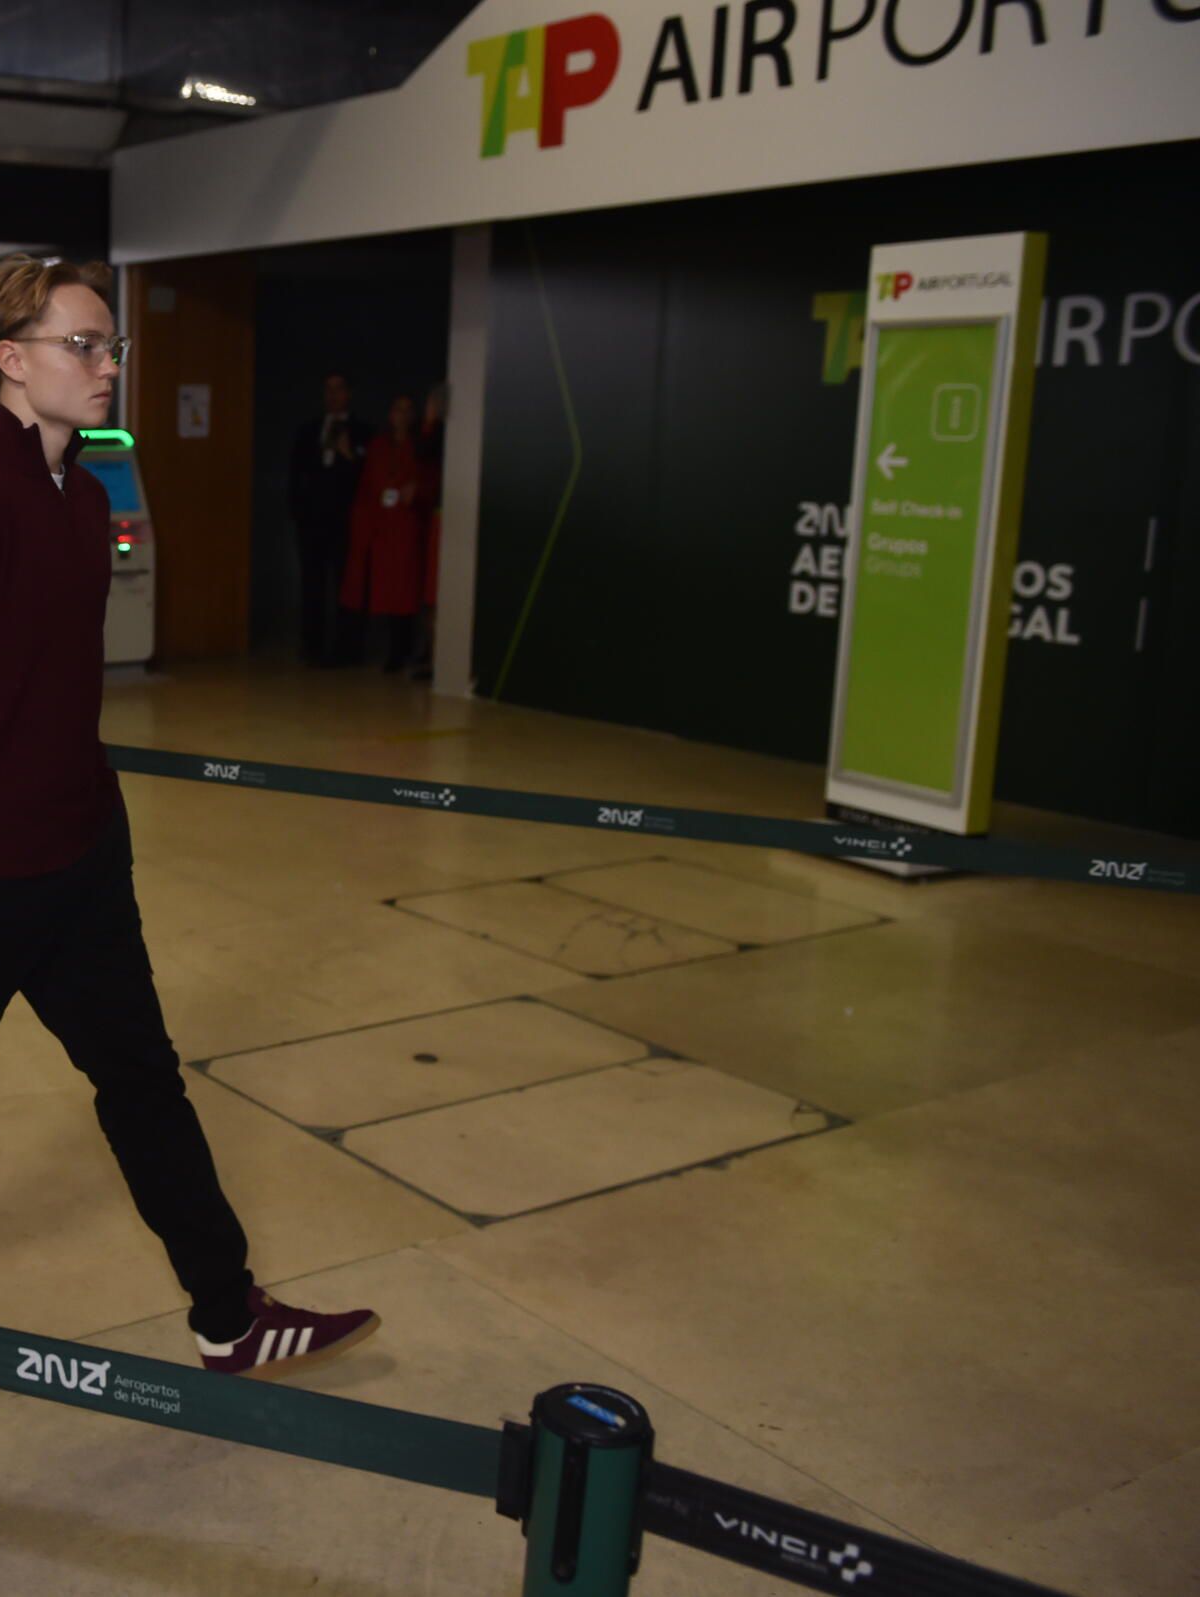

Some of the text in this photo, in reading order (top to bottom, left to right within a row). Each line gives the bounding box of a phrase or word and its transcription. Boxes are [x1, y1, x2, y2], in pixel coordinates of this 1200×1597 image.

[466, 12, 621, 159] TAP
[876, 271, 913, 301] TAP
[788, 581, 840, 618] DE
[393, 788, 437, 801] VINCI
[833, 835, 887, 849] VINCI
[114, 1374, 181, 1399] Aeroportos
[113, 1388, 181, 1415] de Portugal
[713, 1511, 819, 1561] VINCI
